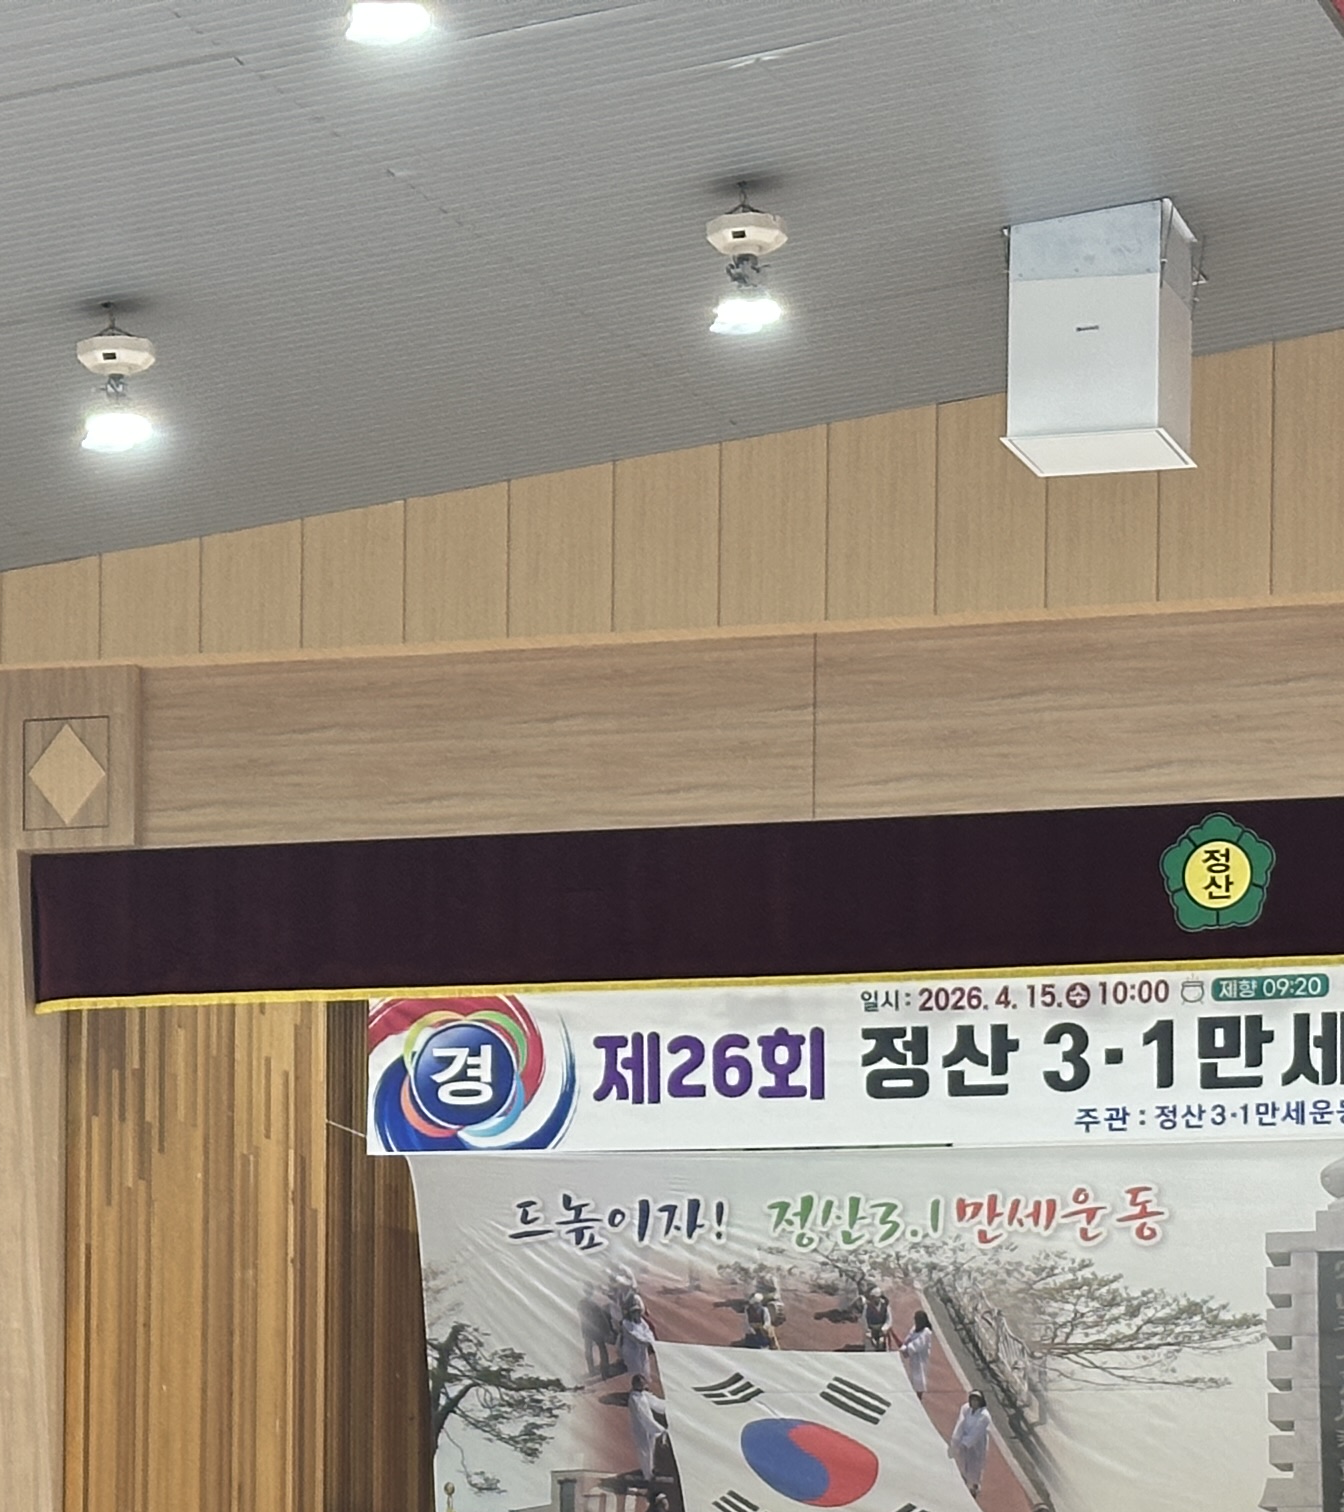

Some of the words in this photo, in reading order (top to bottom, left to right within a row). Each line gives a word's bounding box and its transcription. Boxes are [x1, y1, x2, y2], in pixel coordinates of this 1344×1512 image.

[1098, 979, 1170, 1006] 10:00
[1261, 976, 1322, 998] 09:20
[429, 1043, 495, 1105] 경
[592, 1025, 825, 1104] 제26회
[861, 1022, 1020, 1100] 정산
[508, 1193, 725, 1249] 드높이자!
